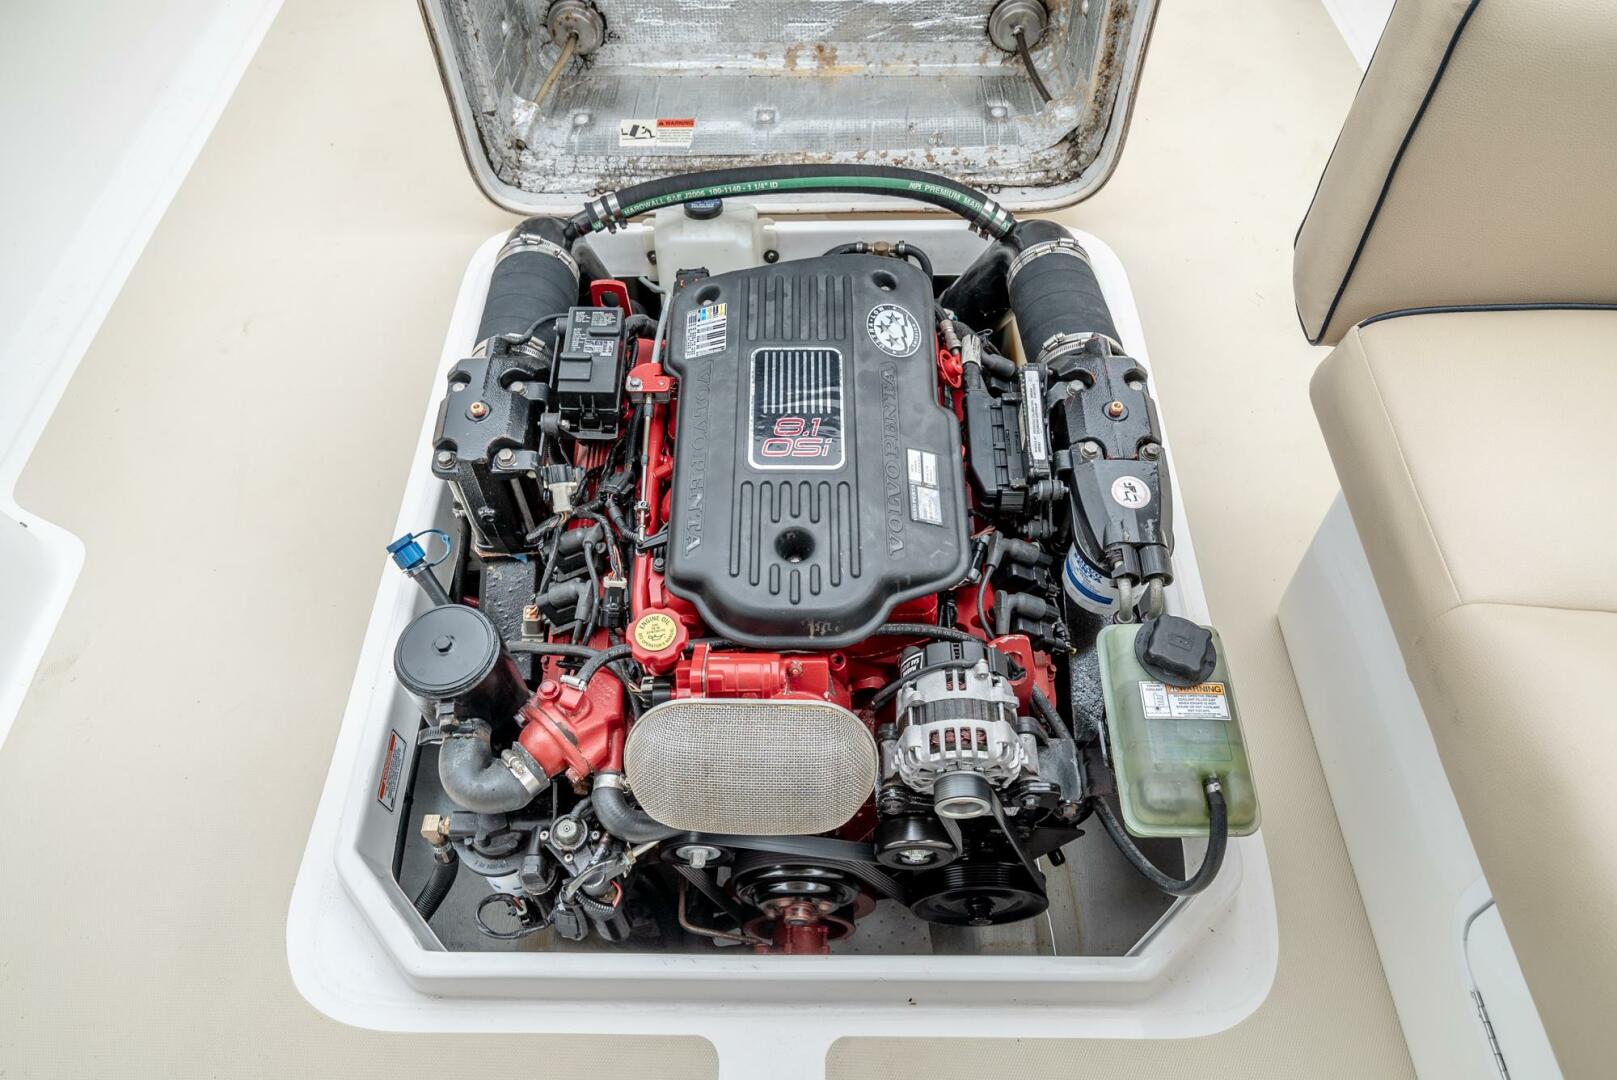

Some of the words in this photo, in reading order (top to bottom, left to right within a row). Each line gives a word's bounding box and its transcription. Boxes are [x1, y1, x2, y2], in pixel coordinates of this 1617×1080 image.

[924, 184, 961, 201] PREMIUM
[773, 417, 822, 437] 8.1
[879, 367, 899, 456] PENTA
[684, 453, 706, 557] PENTA
[884, 459, 906, 557] VOLVO
[639, 615, 660, 630] ENGINE
[661, 616, 671, 626] OIL
